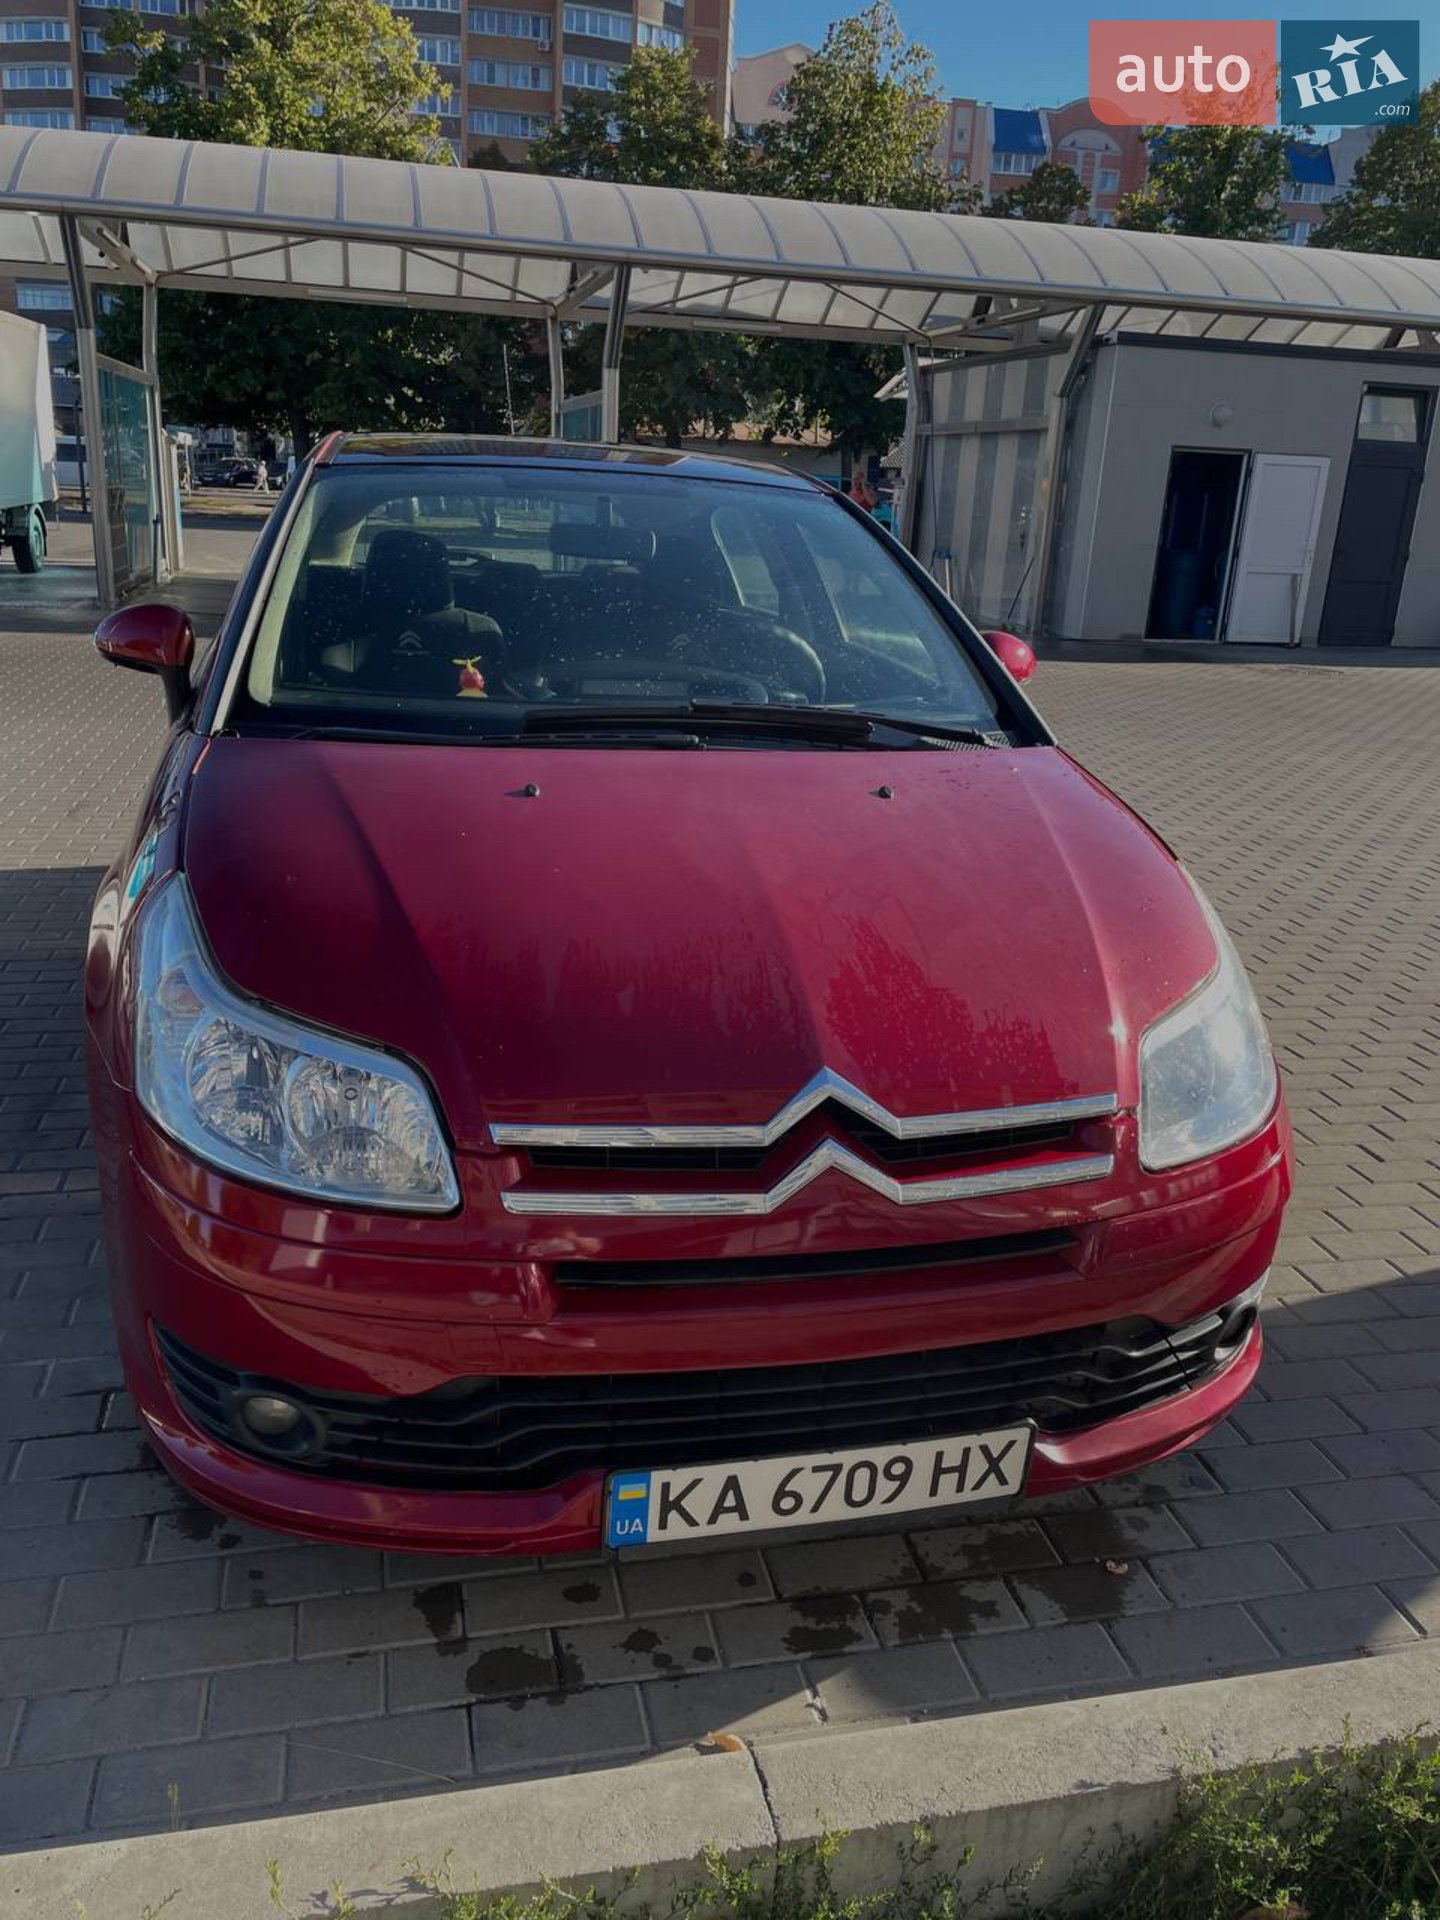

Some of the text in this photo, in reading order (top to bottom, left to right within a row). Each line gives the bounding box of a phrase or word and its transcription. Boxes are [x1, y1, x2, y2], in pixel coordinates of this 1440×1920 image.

[657, 1439, 1018, 1531] KA 6709 HX
[615, 1518, 644, 1537] UA
